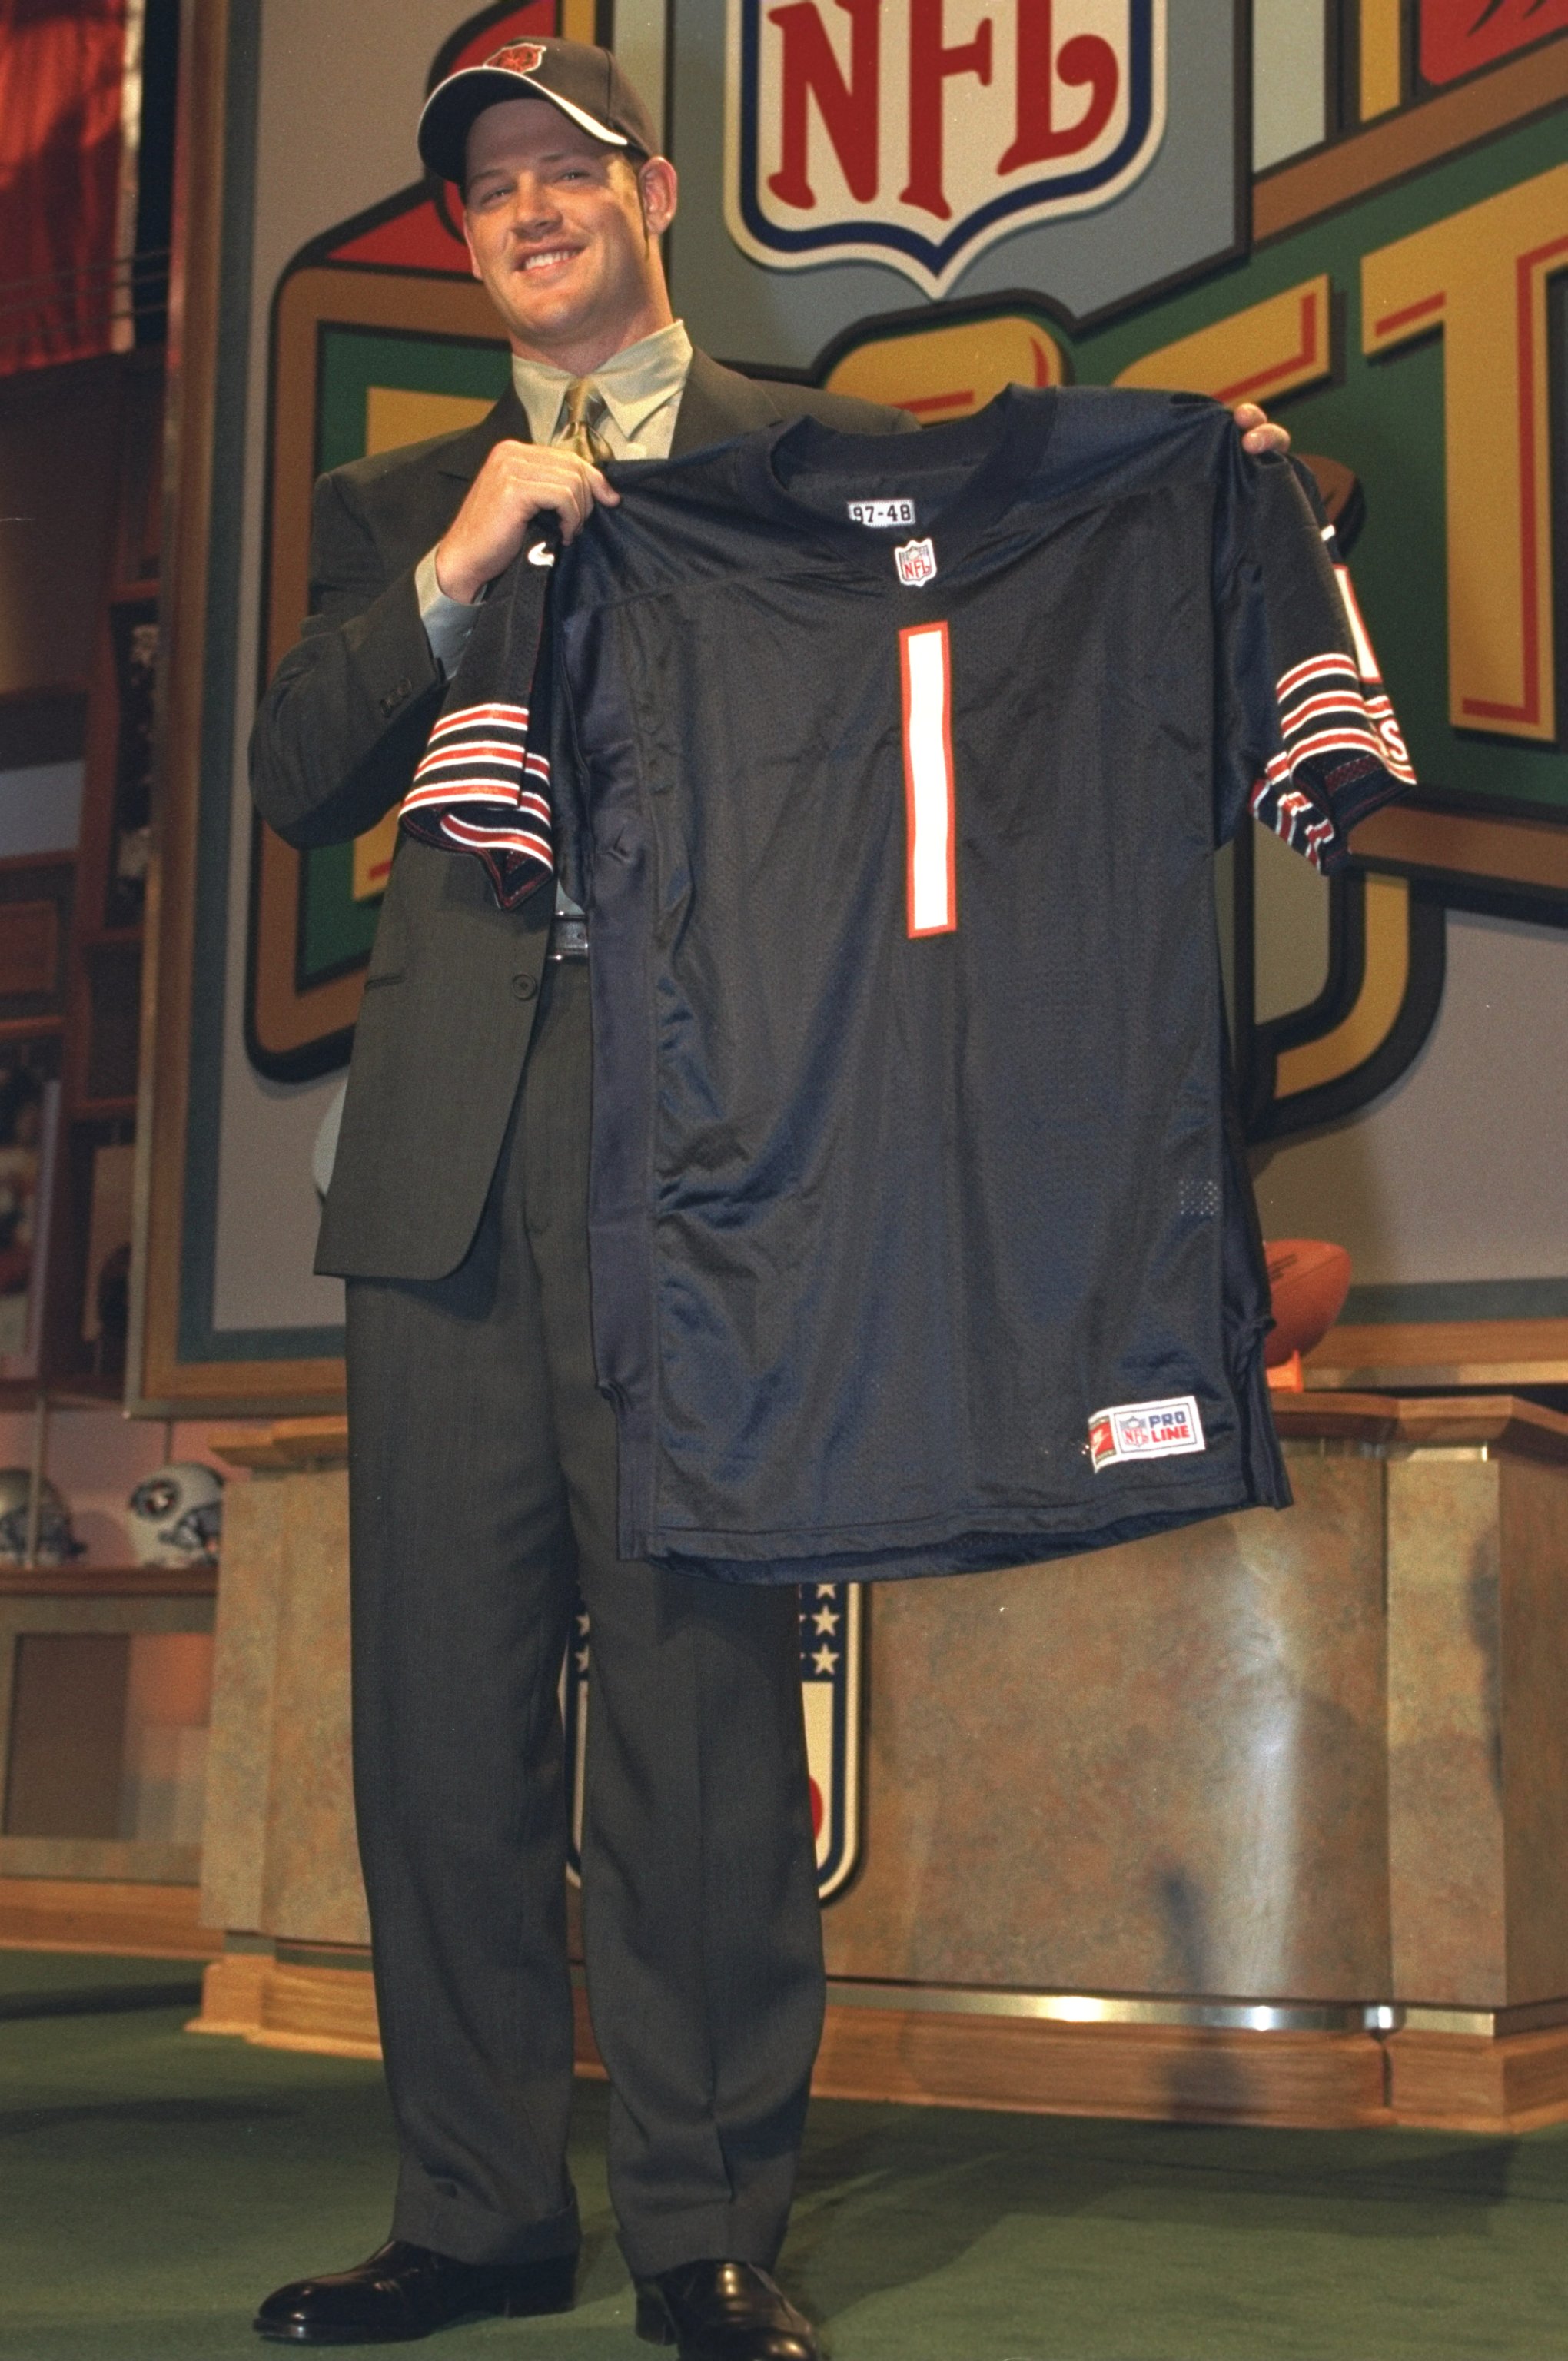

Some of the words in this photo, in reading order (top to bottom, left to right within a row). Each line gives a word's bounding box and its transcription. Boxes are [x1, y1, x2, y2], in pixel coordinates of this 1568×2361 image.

[853, 504, 912, 523] 97-48
[903, 560, 930, 579] NFL
[898, 620, 957, 939] 1
[1148, 1411, 1187, 1429] PRO
[1122, 1428, 1149, 1446] NFL
[1151, 1425, 1190, 1443] LINE
